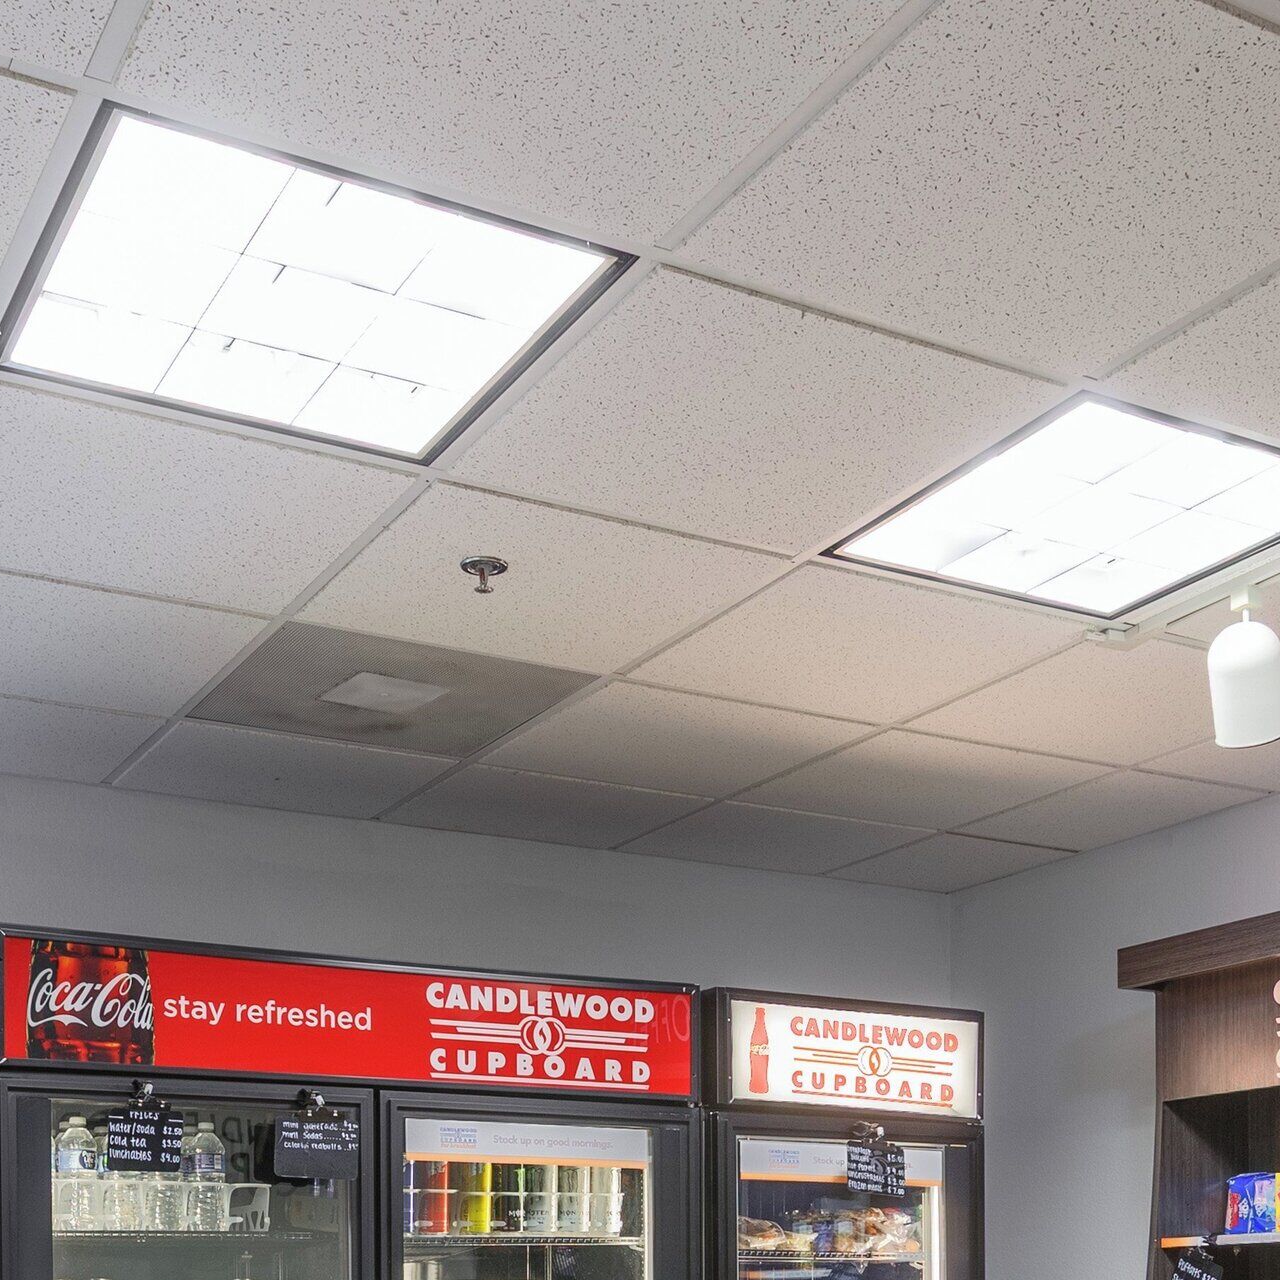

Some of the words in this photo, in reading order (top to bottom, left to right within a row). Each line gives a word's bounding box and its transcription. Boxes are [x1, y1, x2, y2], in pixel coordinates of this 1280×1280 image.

[27, 968, 154, 1031] Coca-Cola
[163, 995, 226, 1026] stay
[235, 1000, 372, 1031] refreshed
[426, 982, 655, 1023] CANDLEWOOD
[790, 1016, 959, 1053] CANDLEWOOD
[429, 1048, 650, 1083] CUPBOARD
[791, 1070, 954, 1101] CUPBOARD
[493, 1135, 519, 1145] Stock
[520, 1137, 532, 1147] up
[546, 1137, 570, 1149] good
